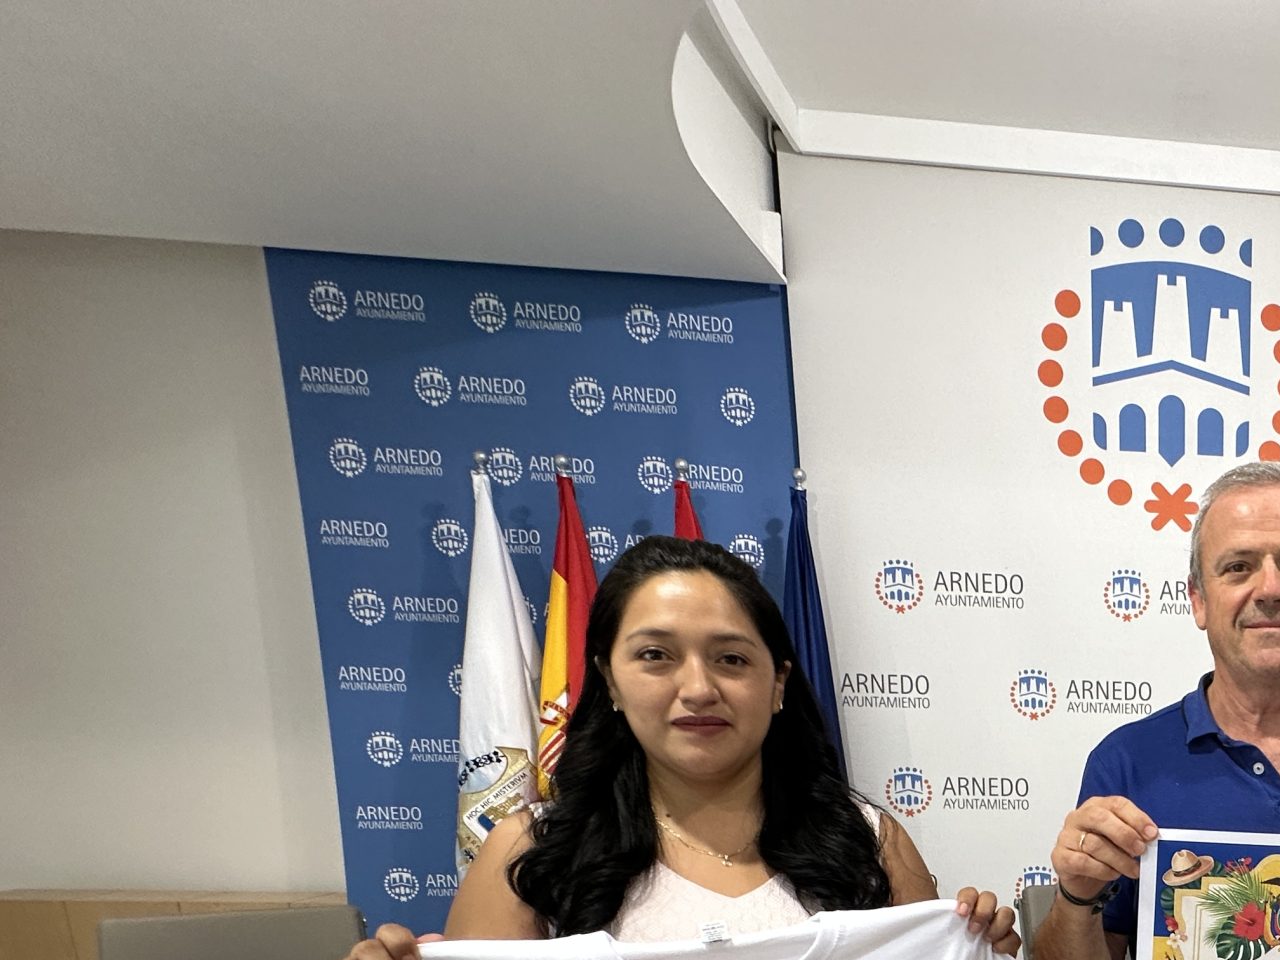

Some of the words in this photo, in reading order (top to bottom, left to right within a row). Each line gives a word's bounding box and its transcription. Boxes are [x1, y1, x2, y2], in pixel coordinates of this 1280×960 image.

[354, 290, 424, 312] ARNEDO
[356, 308, 425, 323] AYUNTAMIENTO
[514, 302, 581, 322] ARNEDO
[515, 318, 582, 332] AYUNTAMIENTO
[667, 313, 733, 334] ARNEDO
[668, 329, 734, 344] AYUNTAMIENTO
[299, 366, 368, 386] ARNEDO
[301, 383, 370, 397] AYUNTAMIENTO
[458, 376, 526, 396] ARNEDO
[460, 392, 527, 406] AYUNTAMIENTO
[612, 386, 677, 405] ARNEDO
[614, 402, 678, 415] AYUNTAMIENTO
[374, 447, 442, 467] ARNEDO
[375, 463, 443, 476] AYUNTAMIENTO
[685, 464, 743, 482] RNEDO
[531, 472, 596, 485] AYUNIENTO
[690, 480, 744, 493] UNTAMIENTO
[320, 519, 388, 537] ARNEDO
[322, 535, 389, 548] AYUNTAMIENTO
[503, 528, 540, 545] NEDO
[507, 543, 542, 555] MIENTO
[935, 571, 1024, 595] ARNEDO
[392, 597, 459, 613] ARNEDO
[935, 594, 1025, 609] AYUNTAMIENTO
[395, 611, 460, 624] AYUNTAMIENTO
[339, 666, 406, 683] ARNEDO
[340, 681, 407, 693] AYUNTAMIENTO
[841, 673, 930, 696] ARNEDO
[1066, 680, 1153, 702] ARNEDO
[842, 694, 931, 709] AYUNTAMIENTO
[1067, 699, 1153, 715] AYUNTAMIENTO
[410, 739, 460, 753] ARNED
[412, 754, 459, 762] AYUNTAMIE
[942, 777, 1030, 798] ARNEDO
[467, 806, 482, 821] HOC
[481, 796, 494, 809] HIC
[494, 772, 528, 801] MISTERIVM
[943, 796, 1030, 810] AYUNTAMIENTO
[356, 805, 422, 821] ARNEDO
[358, 819, 423, 830] AYUNTAMIENTO
[425, 874, 458, 887] ARN
